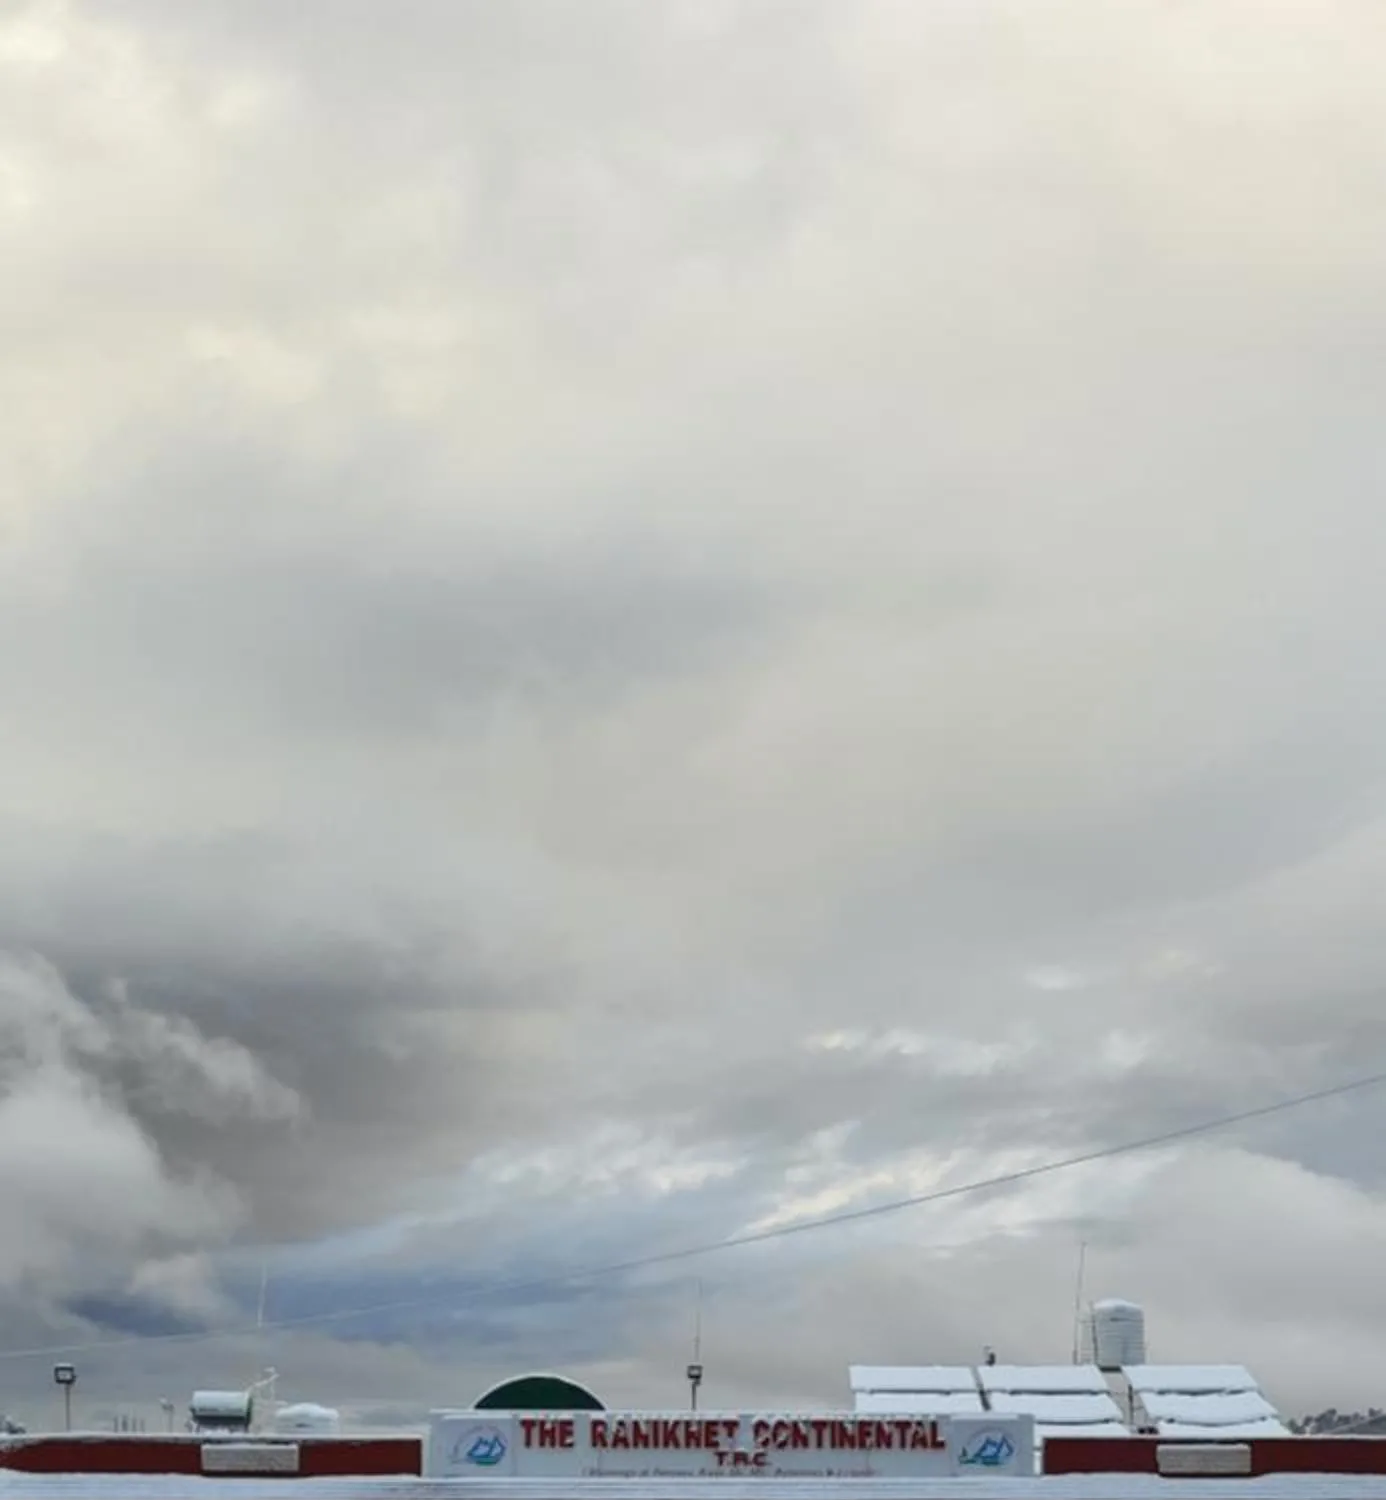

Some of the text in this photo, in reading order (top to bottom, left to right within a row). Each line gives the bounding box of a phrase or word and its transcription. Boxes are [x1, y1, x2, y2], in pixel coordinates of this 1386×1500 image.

[520, 1419, 946, 1449] THE RANIKHET CONTINENTAL
